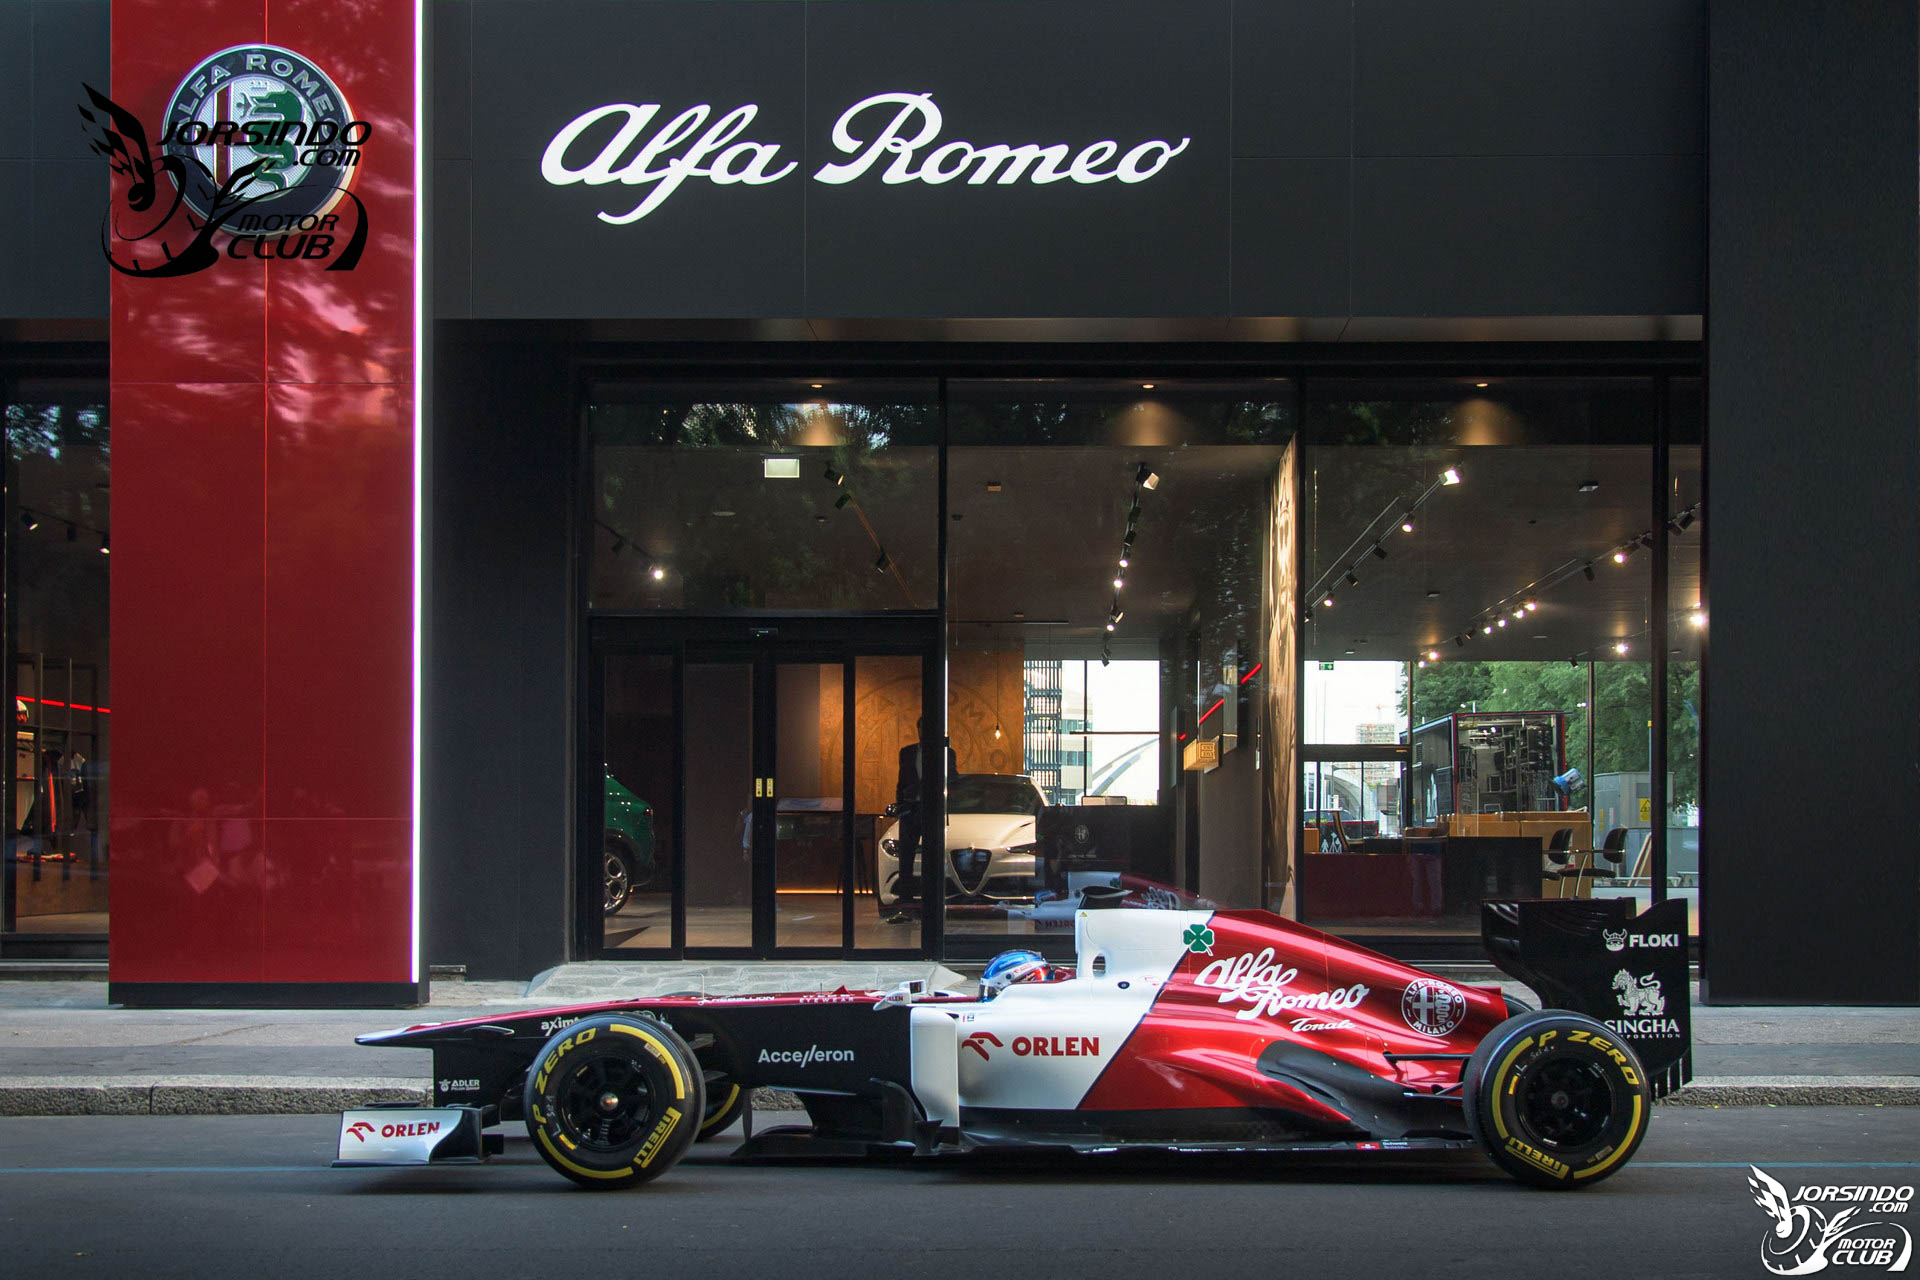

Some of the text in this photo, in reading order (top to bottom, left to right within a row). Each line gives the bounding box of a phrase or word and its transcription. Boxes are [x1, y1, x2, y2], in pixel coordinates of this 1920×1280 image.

[245, 54, 342, 141] ROMEO
[541, 92, 1190, 226] Alfa Romeo
[1629, 934, 1679, 948] FLOKI
[1193, 947, 1370, 1021] Alfa Romeo
[1012, 1036, 1100, 1057] ORLEN
[1413, 1020, 1454, 1034] MILANO
[1604, 1018, 1680, 1033] SINGHA
[532, 1027, 597, 1124] P ZERO
[1539, 1030, 1640, 1085] P ZERO
[451, 1079, 480, 1087] ADLER
[381, 1121, 441, 1138] ORLEN
[633, 1106, 682, 1168] PIRELLI
[1505, 1137, 1570, 1179] PIRELLI
